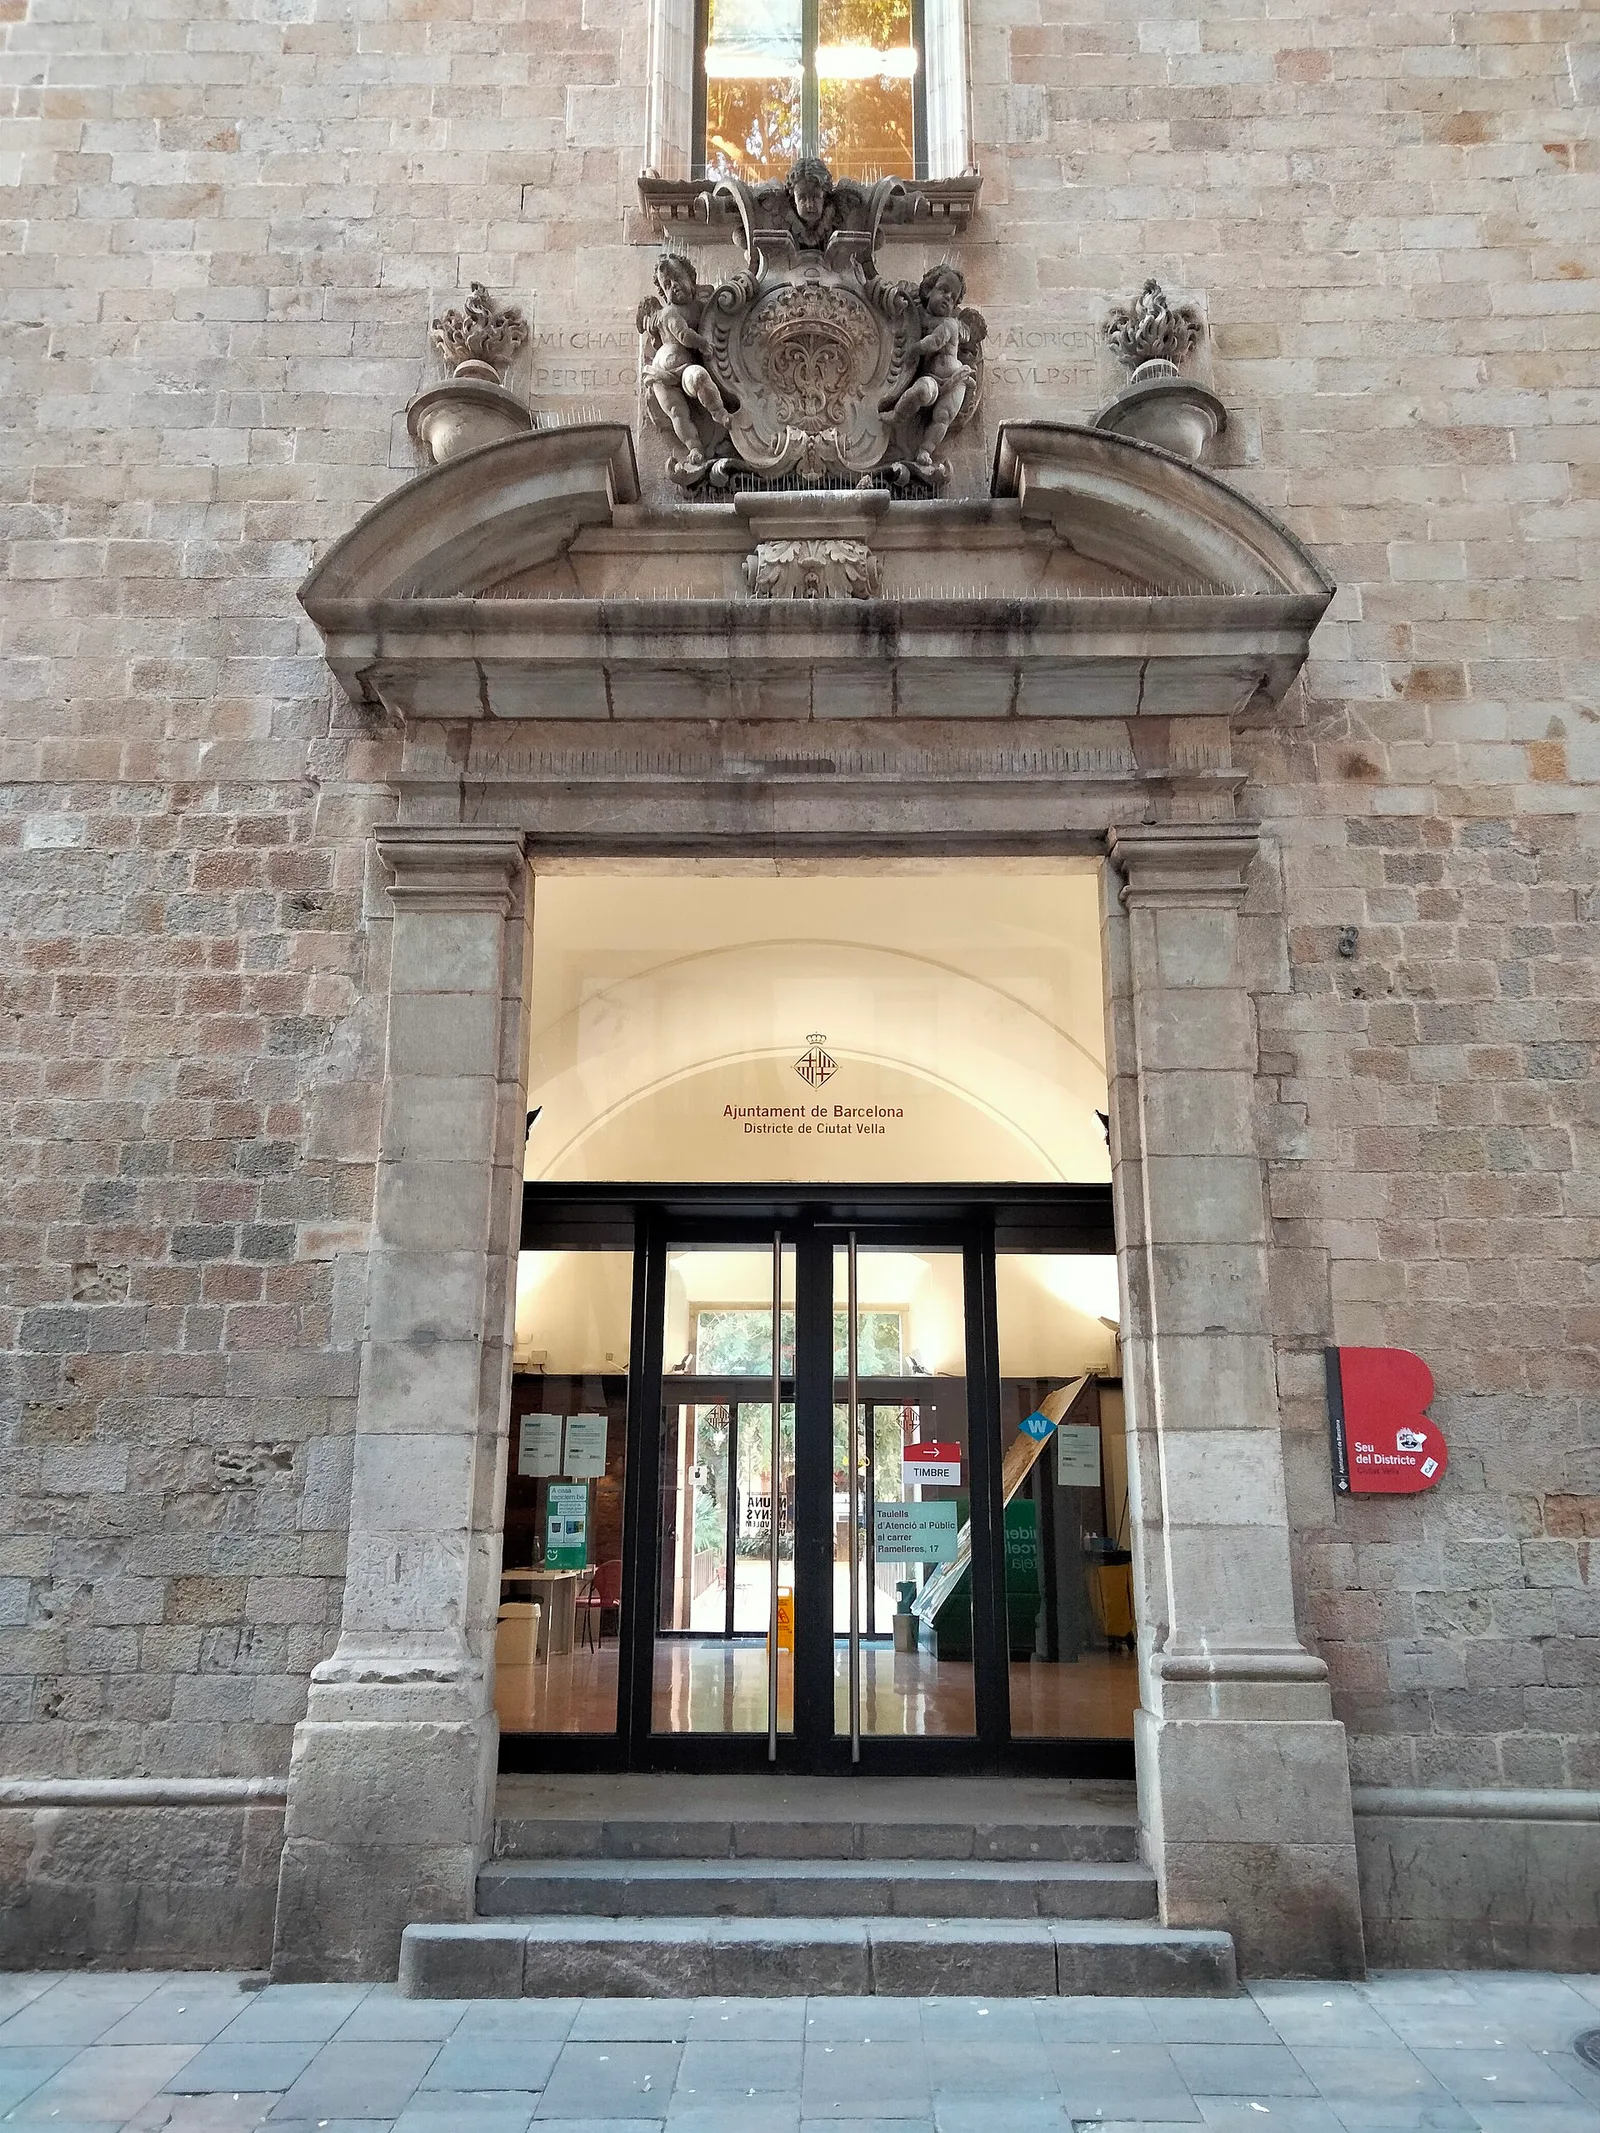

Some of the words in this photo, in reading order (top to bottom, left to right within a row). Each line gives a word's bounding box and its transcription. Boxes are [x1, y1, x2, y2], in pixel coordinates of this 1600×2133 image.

[538, 331, 639, 350] MICHAEL
[535, 368, 638, 387] PERELLO
[723, 1104, 805, 1119] Ajuntament
[810, 1105, 828, 1118] de
[833, 1105, 904, 1118] Barcelona
[744, 1122, 794, 1134] Districte
[797, 1123, 813, 1134] de
[816, 1122, 852, 1134] Ciutat
[856, 1123, 886, 1134] Vella
[1354, 1442, 1375, 1453] Seu
[1356, 1454, 1371, 1464] del
[1374, 1454, 1416, 1465] Districte
[913, 1468, 950, 1477] TIMBRE
[877, 1510, 909, 1518] Taulells
[877, 1521, 917, 1529] d'Atenció
[929, 1521, 956, 1529] Públic
[877, 1533, 885, 1541] al
[878, 1544, 927, 1553] Ramelleres,
[929, 1545, 939, 1553] 17
